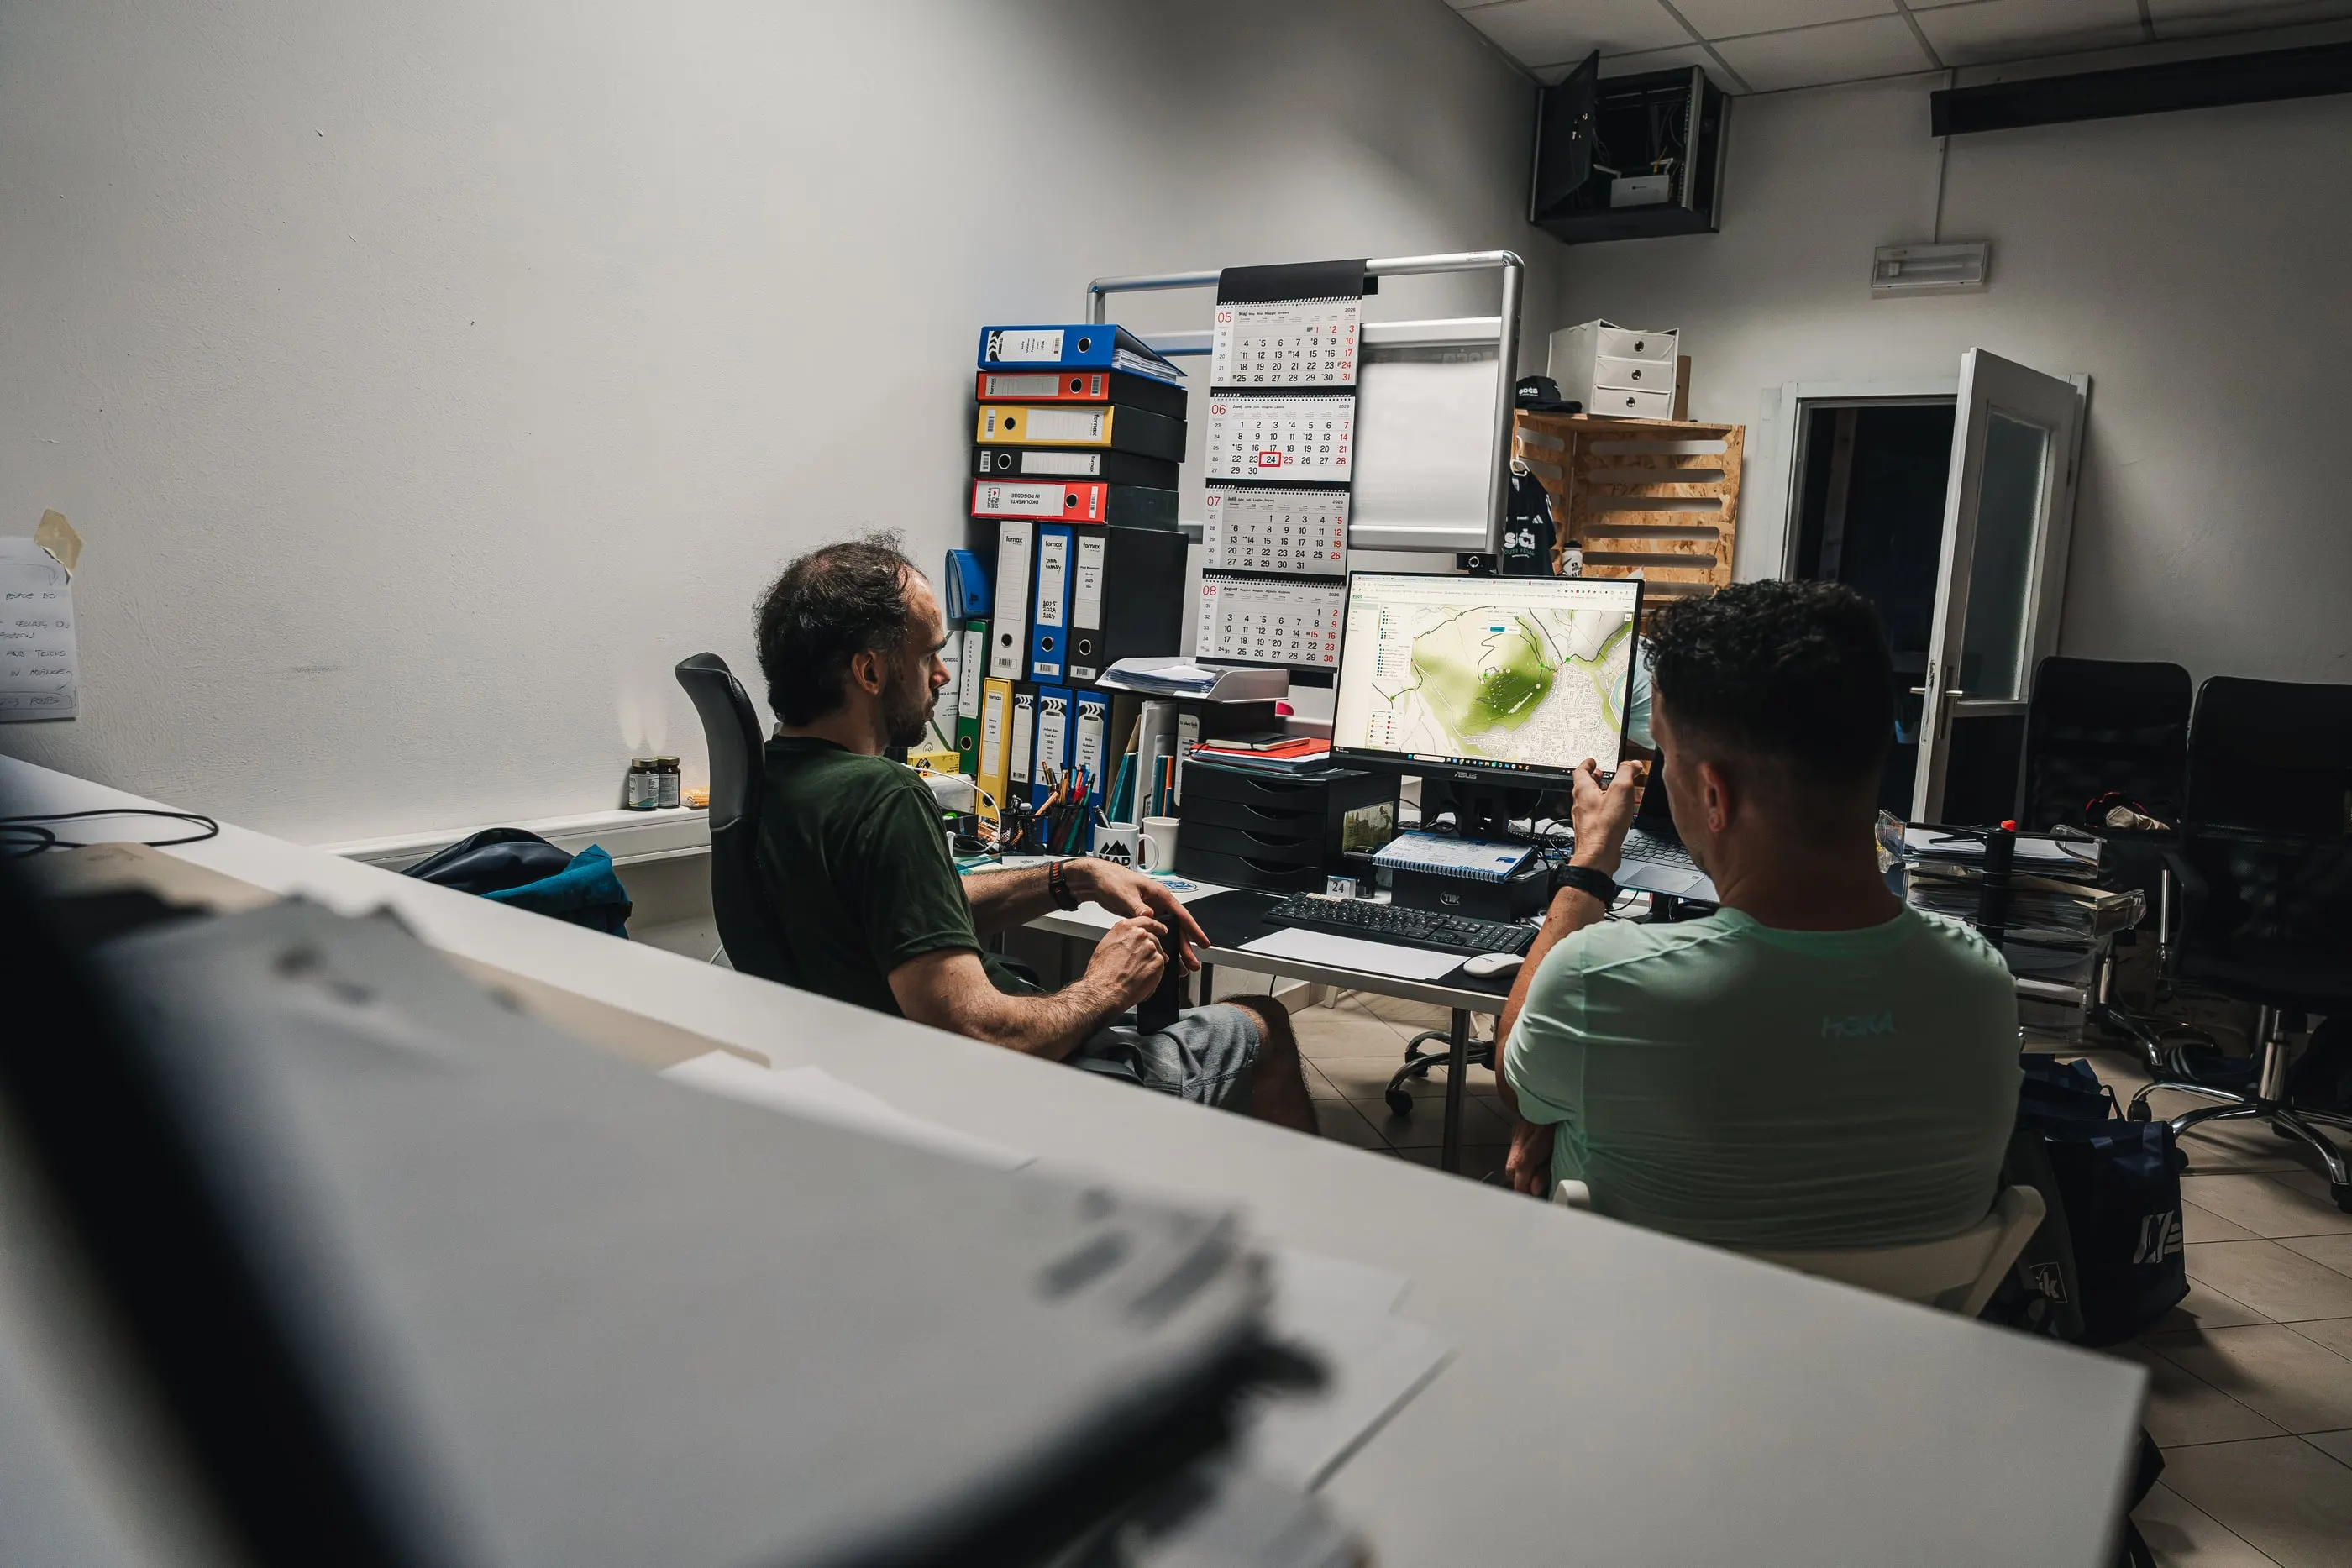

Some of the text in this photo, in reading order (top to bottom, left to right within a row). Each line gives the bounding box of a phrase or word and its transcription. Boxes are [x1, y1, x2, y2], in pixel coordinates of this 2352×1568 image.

[1217, 312, 1232, 323] 05
[1325, 361, 1334, 370] 23
[1342, 373, 1350, 381] 31
[1211, 405, 1226, 415] 06
[1207, 496, 1221, 506] 07
[1203, 585, 1217, 595] 08
[1308, 642, 1317, 650] 22
[1324, 654, 1333, 663] 30
[1454, 771, 1477, 779] ASUS
[1332, 882, 1344, 893] 24
